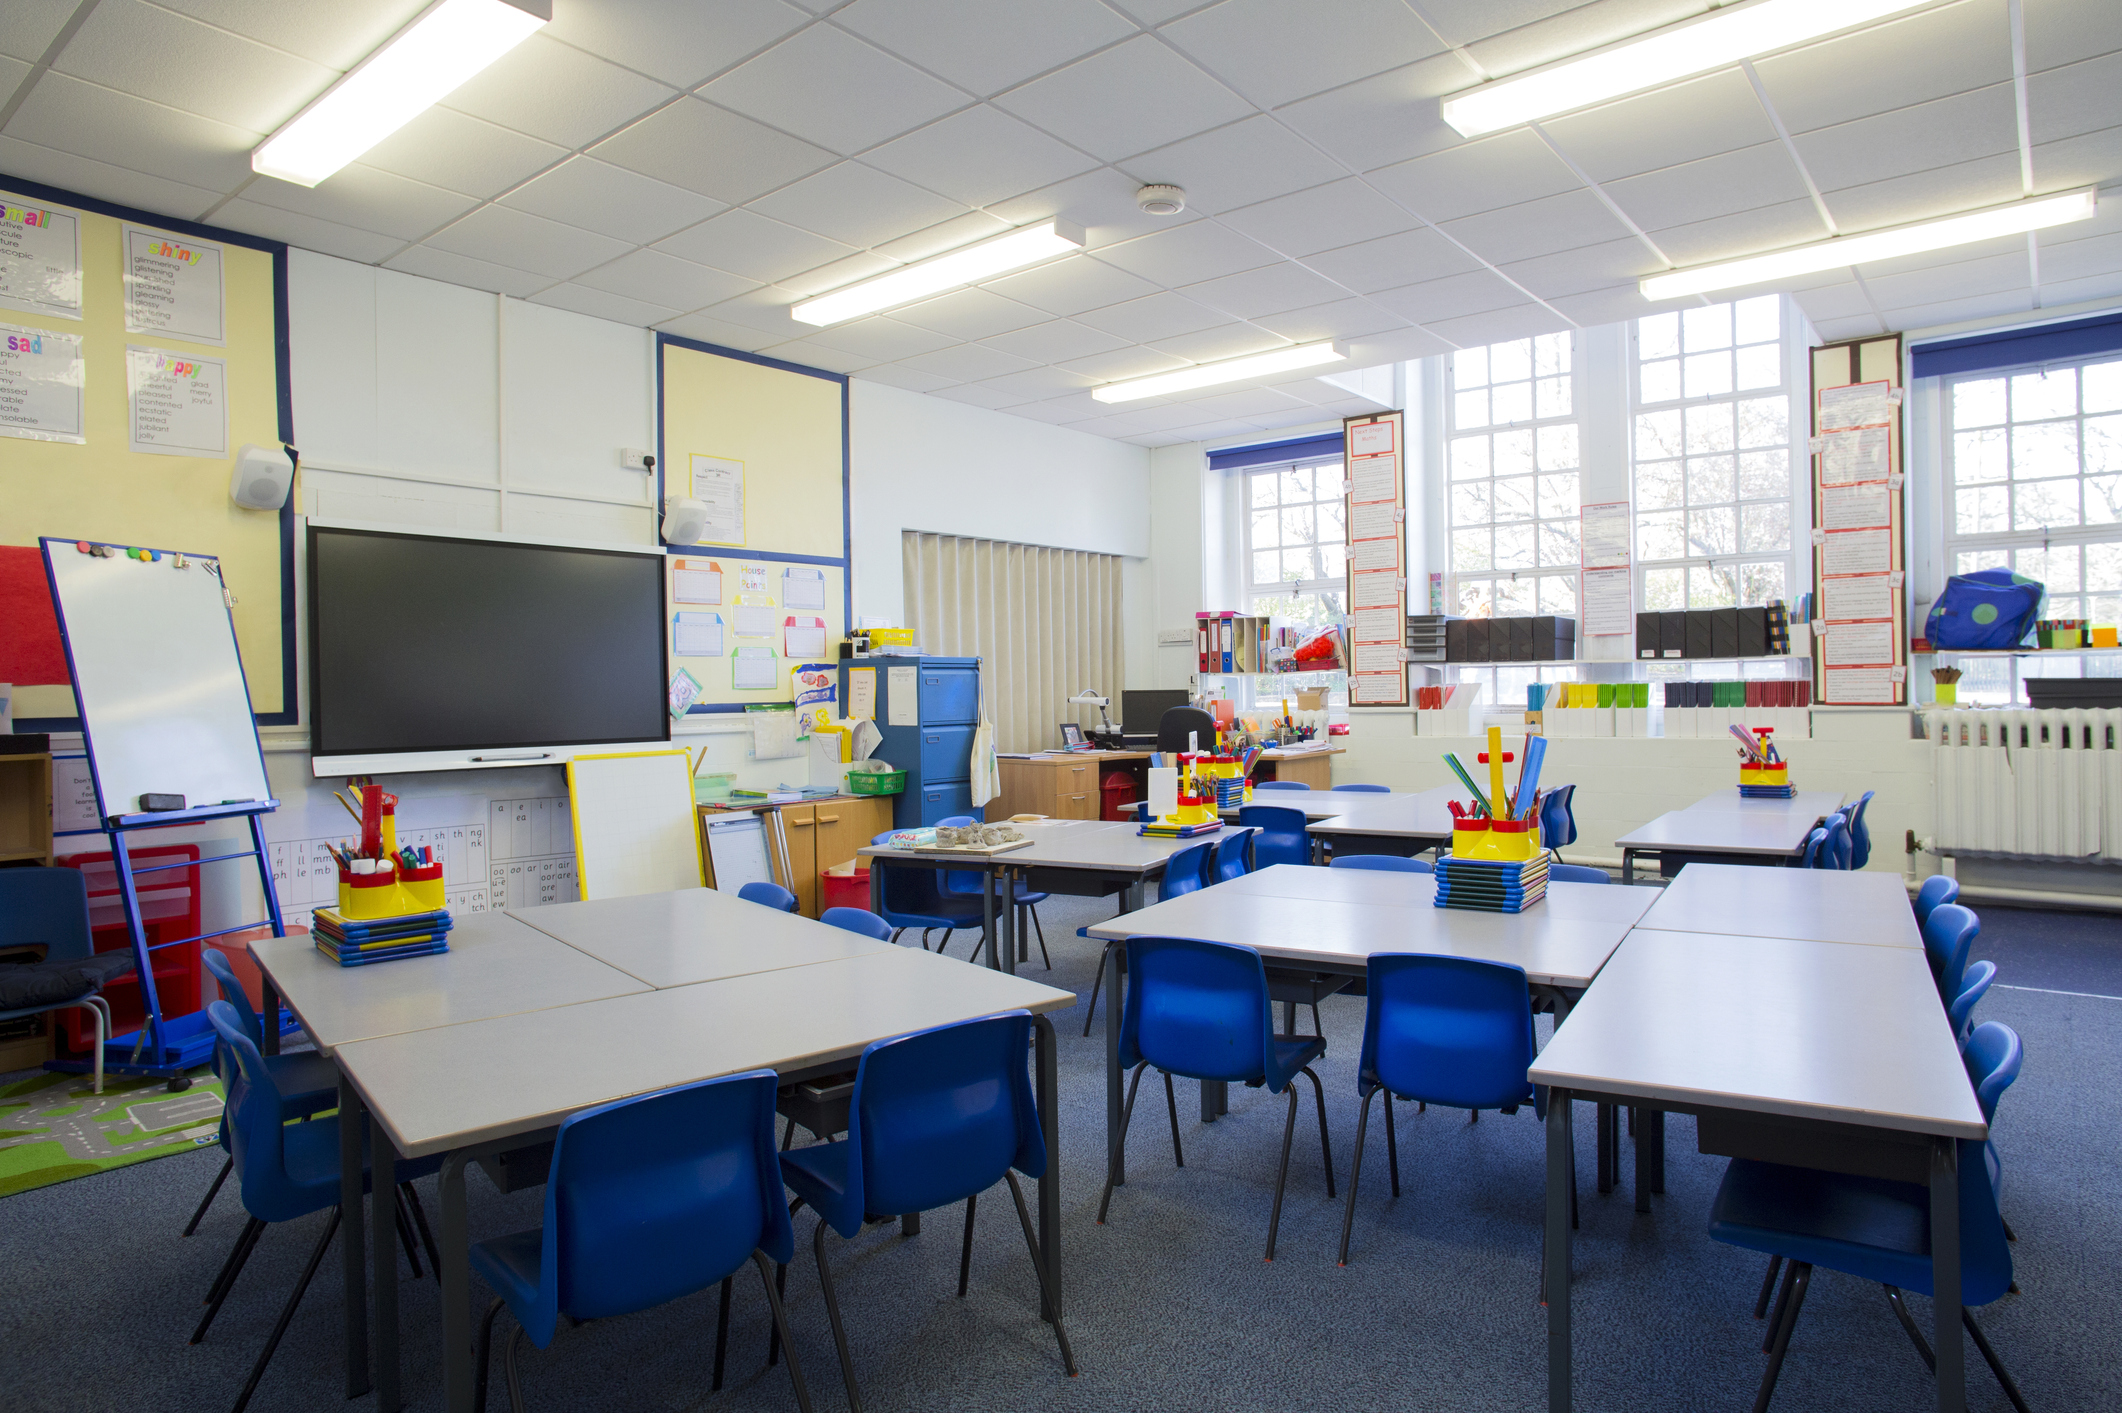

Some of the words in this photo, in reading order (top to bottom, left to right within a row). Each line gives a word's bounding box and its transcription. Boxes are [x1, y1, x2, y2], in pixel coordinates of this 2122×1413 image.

[147, 242, 203, 266] shiny
[134, 256, 180, 271] glimmering
[134, 264, 174, 278] glistening
[135, 282, 172, 295] sparkling
[135, 290, 175, 304] gleaming
[135, 299, 160, 309] glossy
[7, 335, 42, 354] sad
[156, 354, 202, 379] happy
[138, 390, 172, 400] pleased
[190, 389, 212, 397] merry
[139, 398, 183, 409] contented
[139, 407, 173, 416] ecstatic
[139, 415, 167, 424] elated
[139, 423, 169, 432] jubilant
[138, 432, 155, 440] jolly
[741, 565, 766, 575] House
[741, 579, 766, 590] Points
[435, 831, 445, 840] sh
[453, 829, 463, 838] th
[470, 829, 482, 838] ng
[437, 843, 444, 851] ti
[471, 839, 482, 847] nk
[278, 846, 282, 855] f
[313, 855, 332, 863] mm
[436, 854, 444, 862] ci
[276, 859, 284, 867] ff
[558, 861, 570, 869] air
[297, 868, 306, 877] le
[314, 865, 331, 875] mb
[493, 868, 504, 876] oo
[273, 870, 287, 880] ph
[541, 873, 556, 881] oor
[541, 884, 555, 892] ore
[472, 892, 483, 901] ch
[494, 890, 504, 898] ue
[460, 896, 466, 904] y
[471, 902, 485, 912] tch
[492, 901, 505, 909] ew
